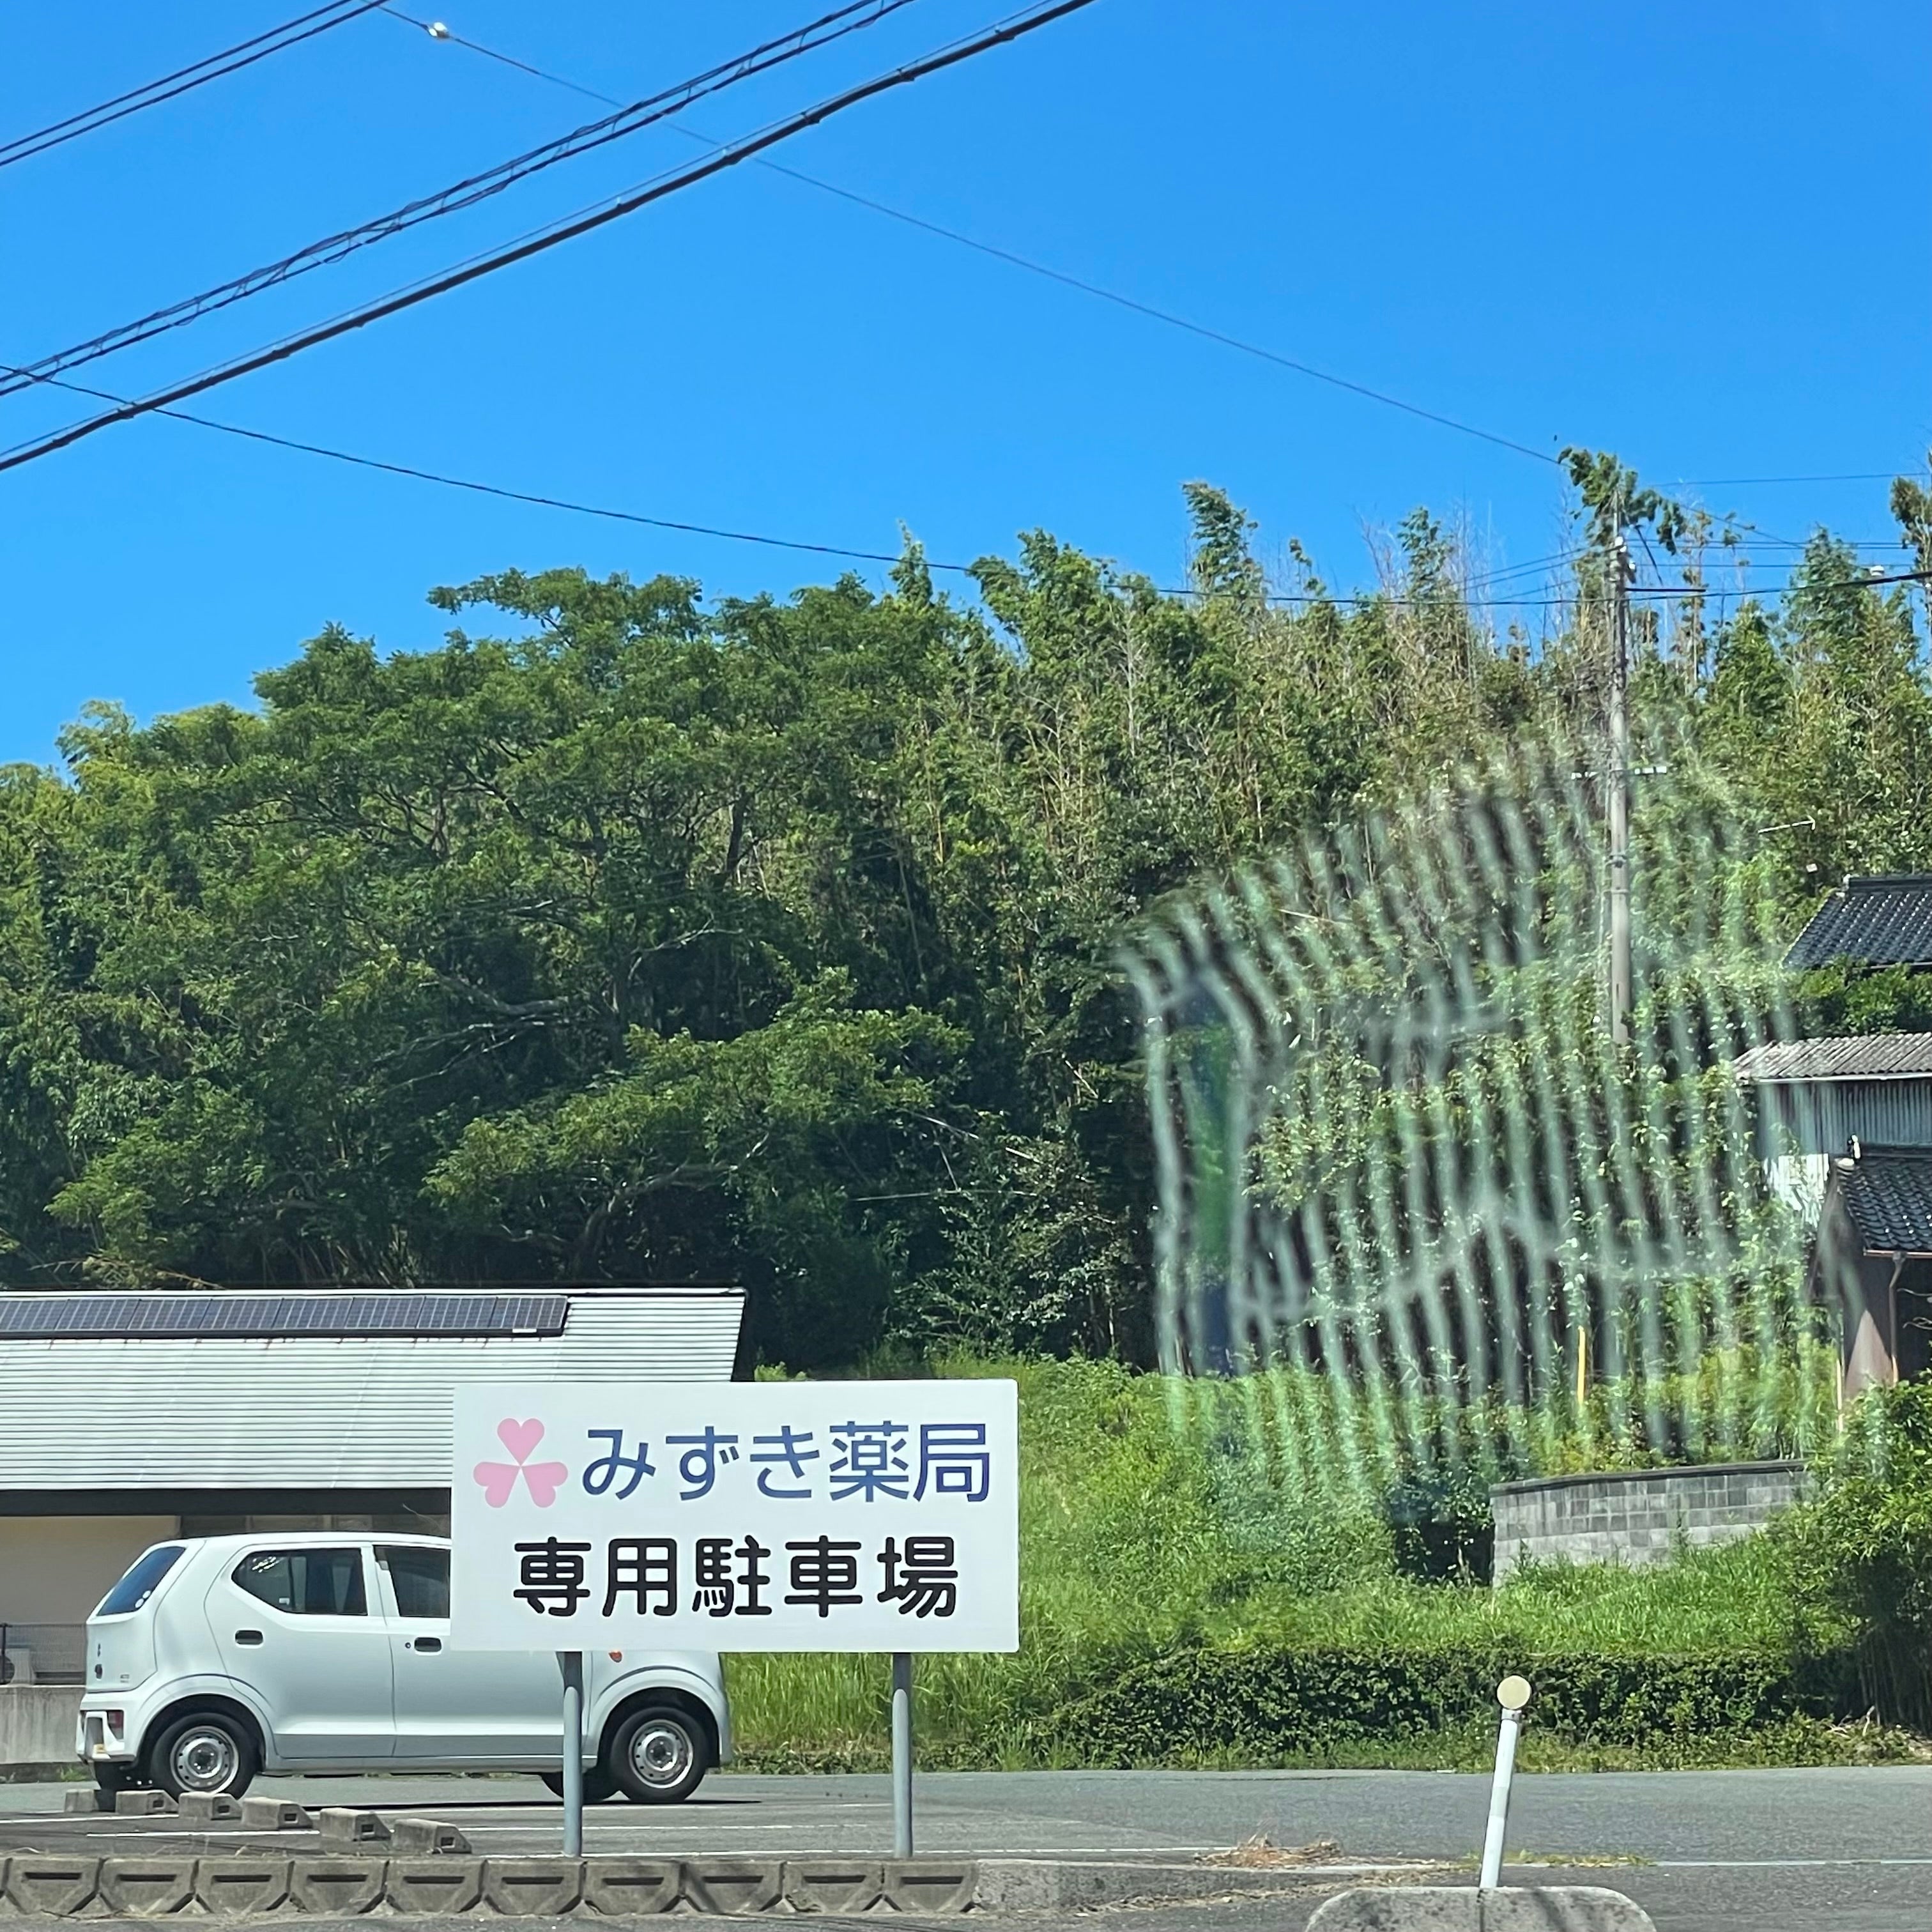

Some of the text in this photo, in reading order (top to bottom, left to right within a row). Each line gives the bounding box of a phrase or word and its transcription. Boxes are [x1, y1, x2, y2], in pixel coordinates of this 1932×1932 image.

[582, 1420, 990, 1503] みずき薬局
[513, 1535, 959, 1618] 専用駐車場
